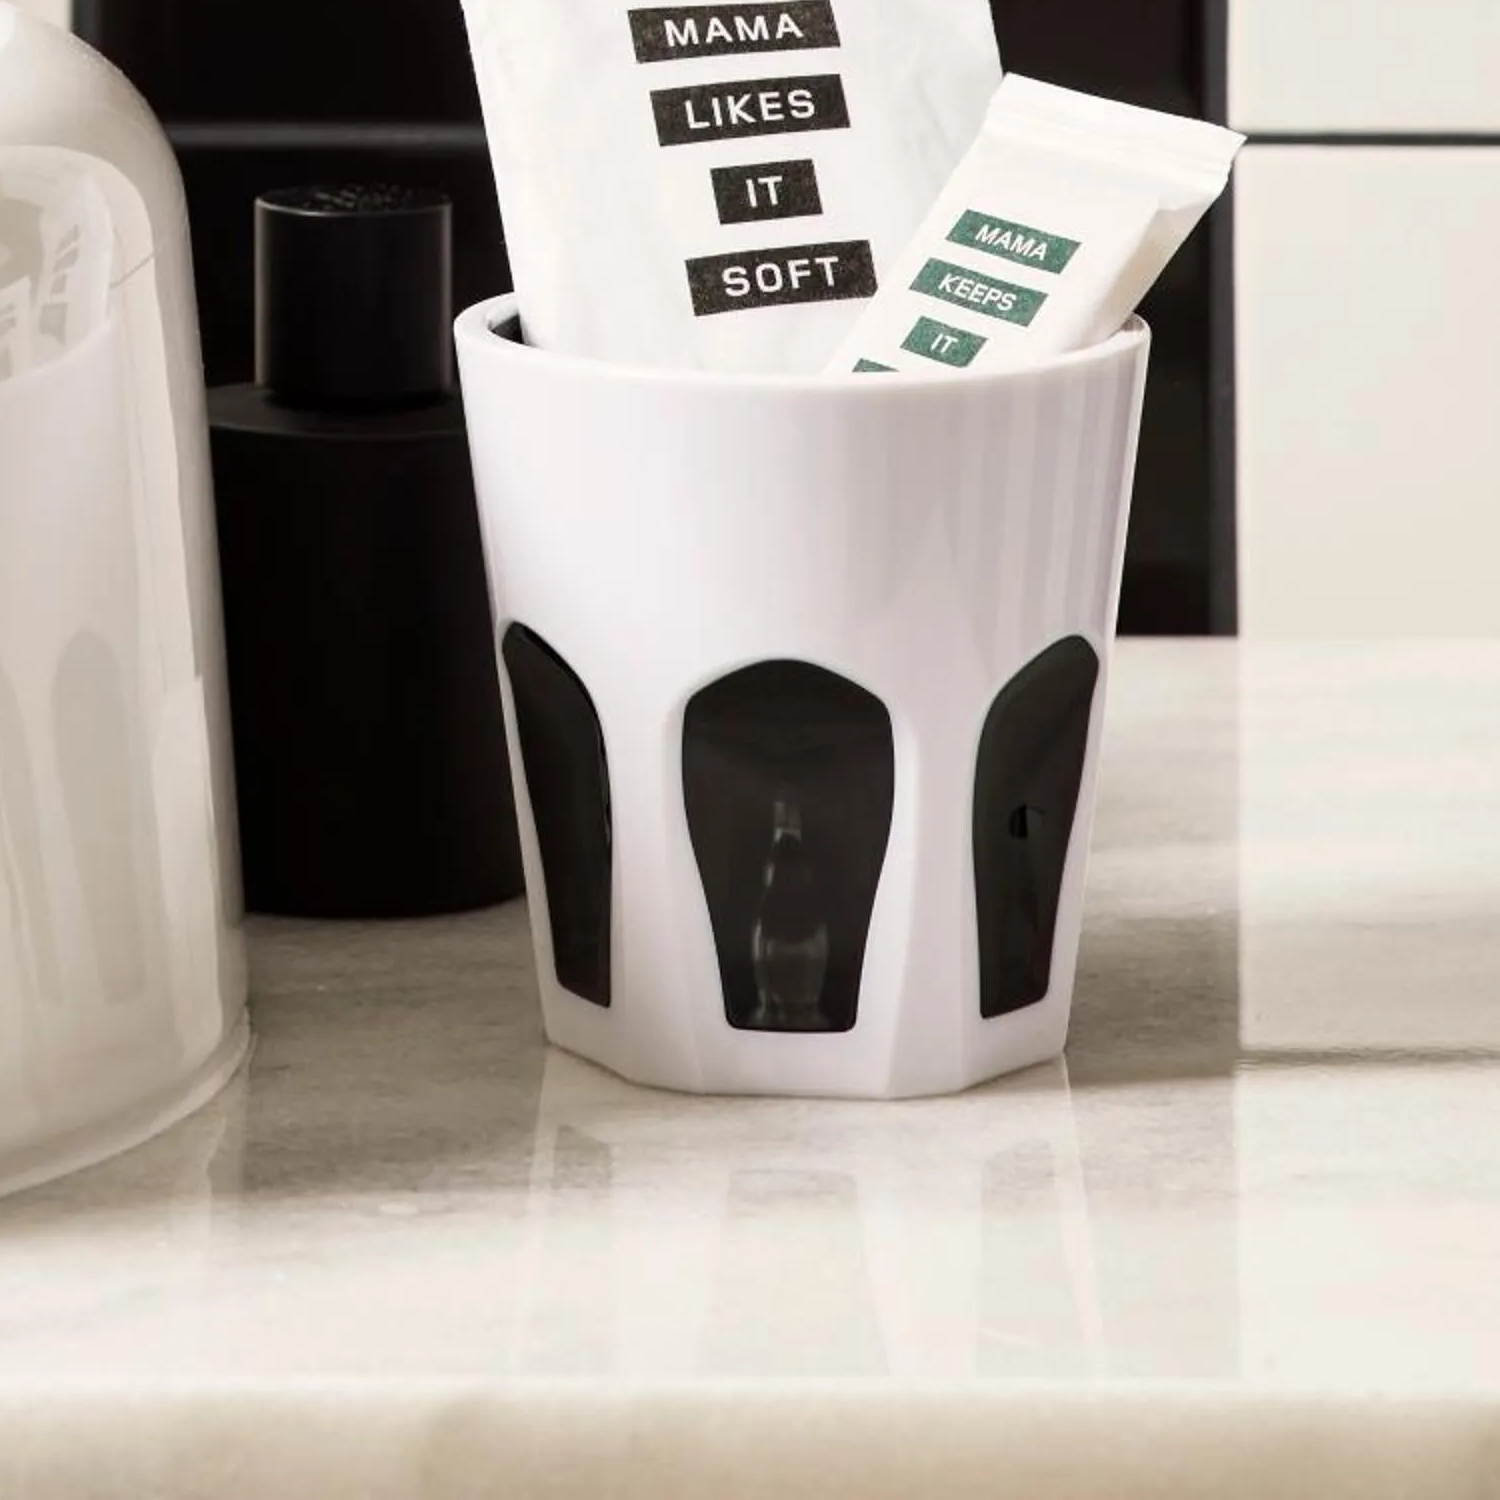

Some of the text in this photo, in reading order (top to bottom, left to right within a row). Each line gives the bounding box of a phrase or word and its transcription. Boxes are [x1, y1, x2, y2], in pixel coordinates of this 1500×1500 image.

[663, 13, 804, 47] MAMA
[684, 89, 816, 130] LIKES
[745, 175, 783, 208] IT
[975, 224, 1046, 261] MAMA
[722, 256, 839, 297] SOFT
[938, 273, 1017, 311] KEEPS
[930, 333, 959, 353] IT
